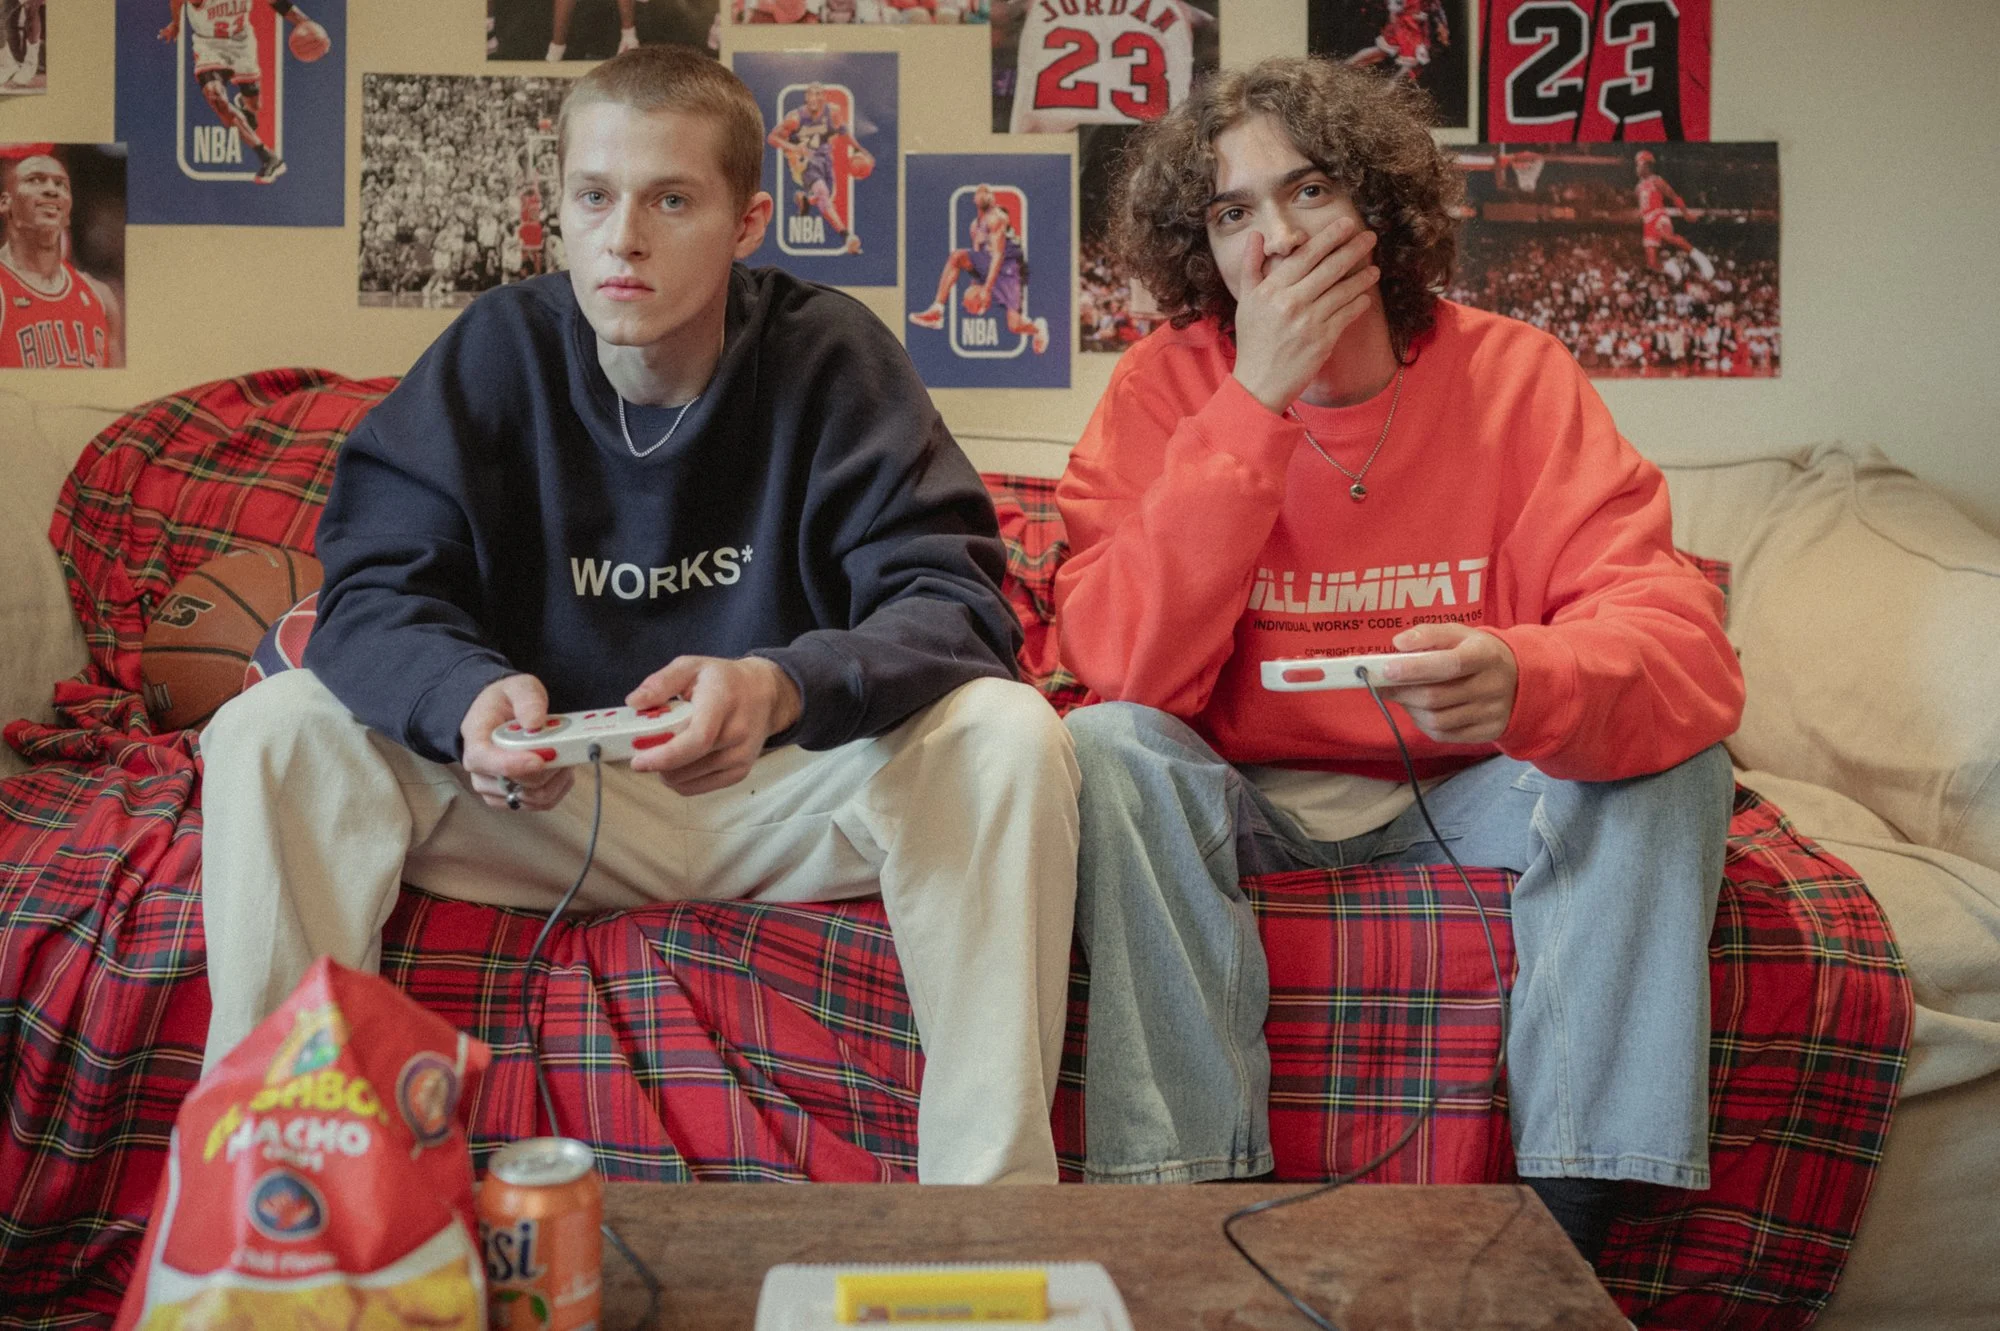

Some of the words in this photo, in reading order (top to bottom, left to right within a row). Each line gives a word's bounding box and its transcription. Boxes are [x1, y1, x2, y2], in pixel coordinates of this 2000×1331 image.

[1040, 0, 1178, 33] JORDAN
[1033, 27, 1170, 123] 23
[1506, 0, 1679, 125] 23
[194, 125, 242, 163] NBA
[788, 215, 825, 243] NBA
[961, 317, 999, 346] NBA
[1253, 620, 1311, 633] INDIVIDUAL
[1368, 617, 1403, 629] CODE
[1304, 646, 1355, 657] COPYRIGHT
